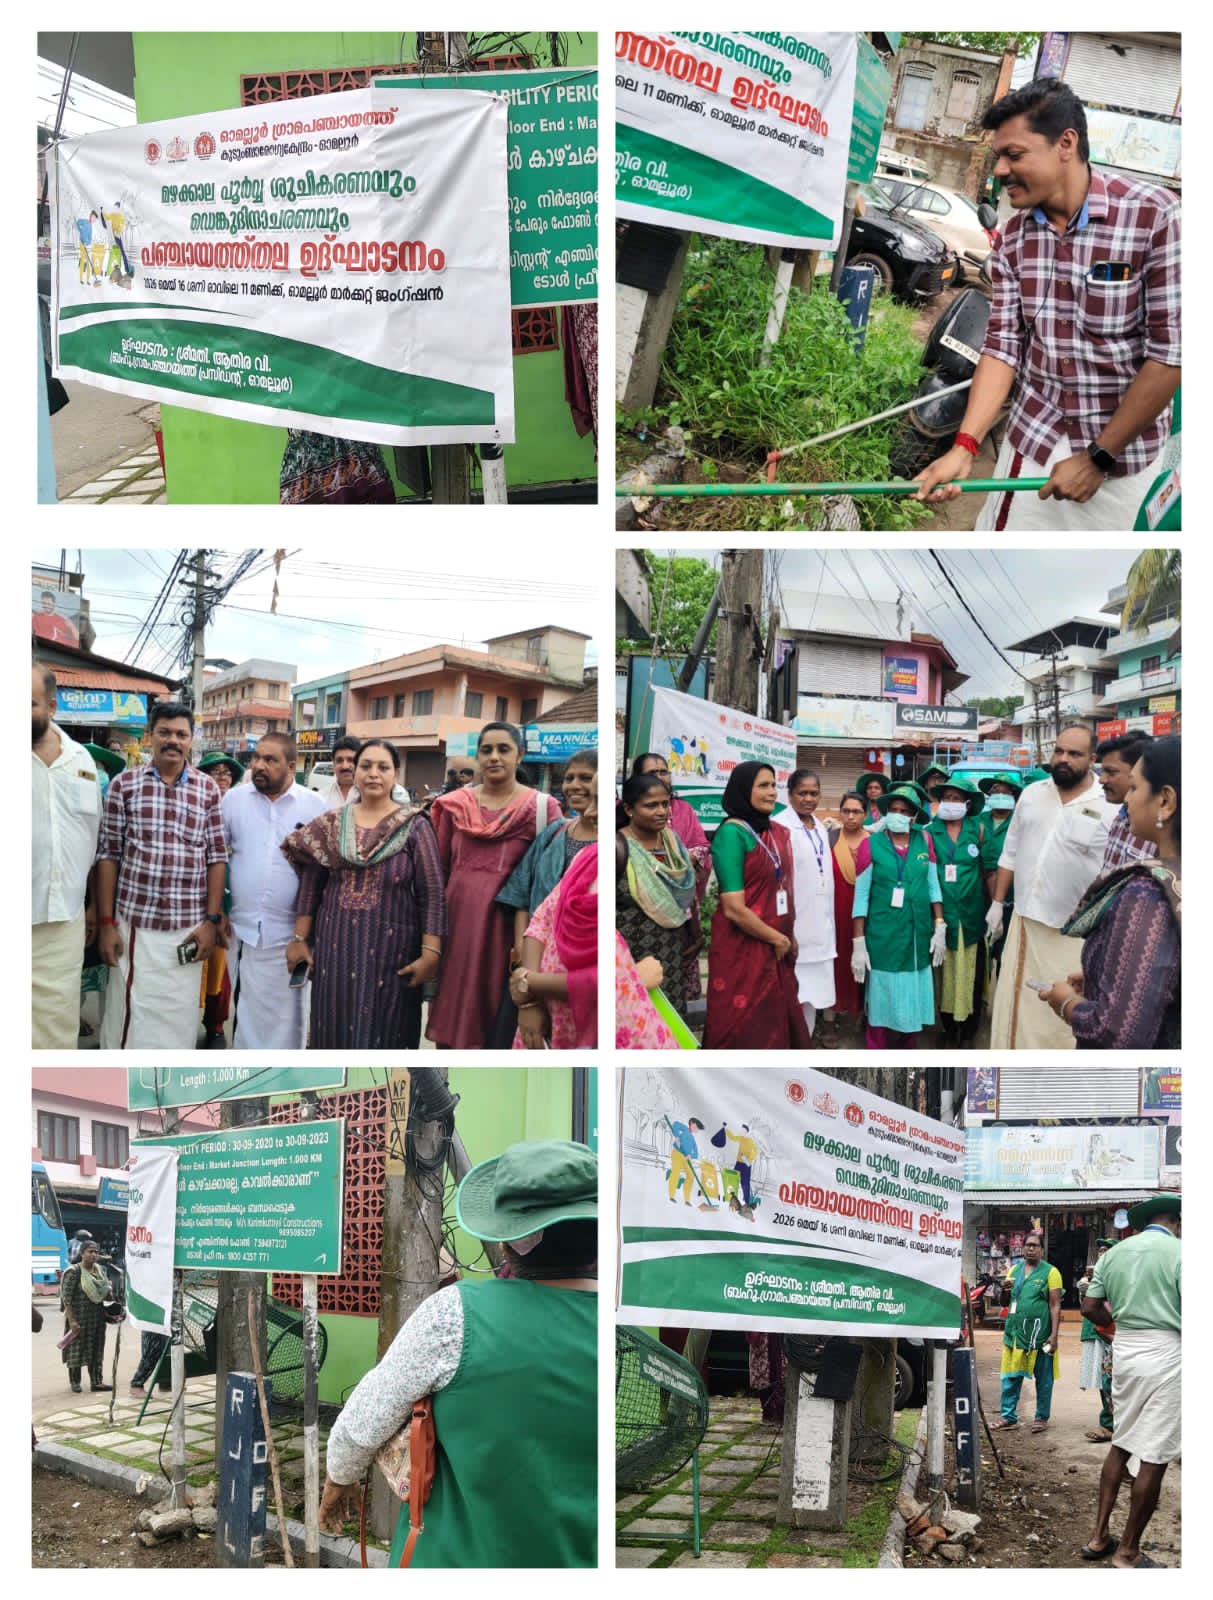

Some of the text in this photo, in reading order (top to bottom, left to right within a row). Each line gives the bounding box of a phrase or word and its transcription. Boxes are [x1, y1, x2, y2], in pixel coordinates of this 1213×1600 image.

[643, 83, 655, 98] 11
[710, 107, 756, 132] ഓമല്ലൂർ
[220, 107, 399, 145] ഓമല്ലൂർ ഗ്രാമപഞ്ചായത്ത്
[540, 117, 565, 132] End
[646, 160, 669, 178] വി.
[161, 169, 417, 204] മഴക്കാല പൂർവ്വ ശുചീകരണവും
[537, 188, 598, 209] നിർദ്ദേശ
[190, 205, 349, 235] ഡെങ്കുദിനാചരണവും
[300, 234, 445, 278] ഉദ്ഘാടനം
[177, 279, 185, 292] 16
[187, 279, 206, 293] ശനി
[241, 283, 248, 295] 11
[288, 285, 327, 301] ഓമല്ലൂർ
[330, 286, 374, 304] മാർക്കറ്റ്
[213, 350, 251, 370] ആതിര
[180, 1072, 206, 1088] Length
[212, 1068, 234, 1084] 1.000
[236, 1067, 250, 1081] Km
[868, 1110, 907, 1134] ഓമല്ലൂർ
[201, 1142, 227, 1153] PERIOD
[275, 1138, 284, 1148] to
[285, 1132, 329, 1147] 30-09-2023
[803, 1130, 861, 1163] മഴക്കാല
[866, 1152, 900, 1178] പൂർവ്വ
[835, 1167, 949, 1212] ഡെങ്കുദിനാചരണവും
[772, 1213, 795, 1227] 2026
[797, 1219, 820, 1232] മെയ്
[820, 1222, 828, 1233] 16
[830, 1225, 847, 1237] ശനി
[877, 1233, 883, 1244] 11
[918, 1211, 964, 1240] ഉദ്ഘാ
[744, 1271, 802, 1291] ഉദ്ഘാടനം
[810, 1279, 847, 1295] ശ്രീമതി.
[849, 1284, 881, 1300] ആതിര
